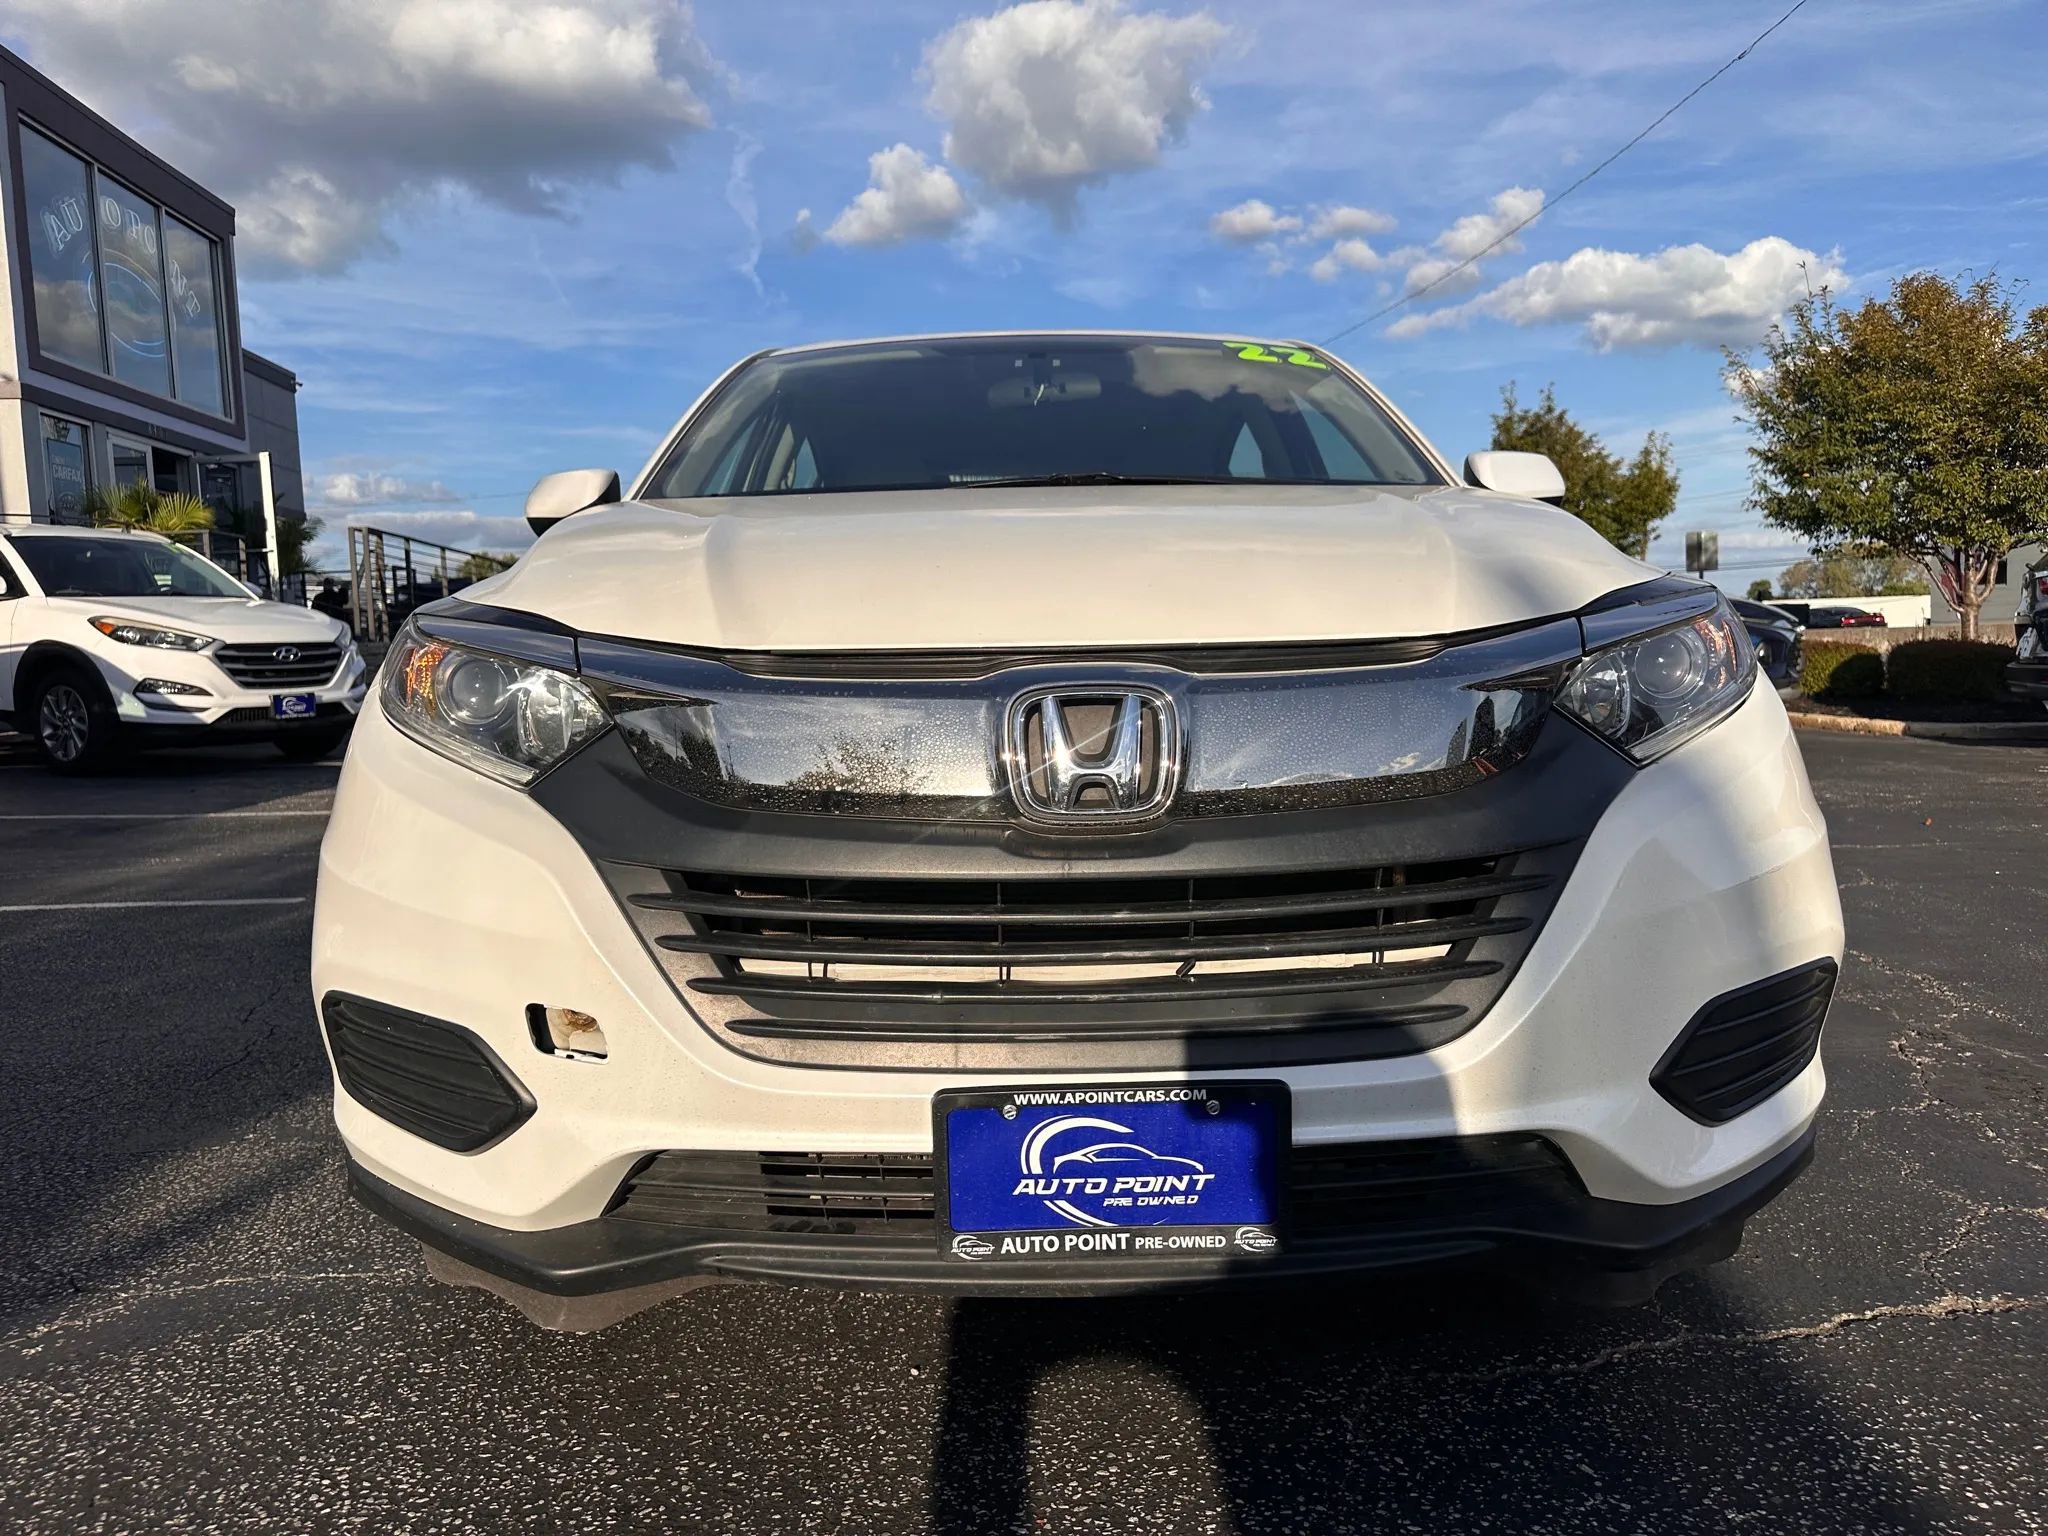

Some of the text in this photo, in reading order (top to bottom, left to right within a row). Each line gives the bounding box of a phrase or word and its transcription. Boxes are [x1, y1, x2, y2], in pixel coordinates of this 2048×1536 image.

[1222, 342, 1326, 369] 22
[52, 464, 82, 483] CARFAX
[1014, 1089, 1206, 1105] WWW.APOINTCARS.COM
[1012, 1174, 1215, 1195] AUTO POINT
[1103, 1195, 1198, 1206] PRE OWNED
[1001, 1233, 1226, 1254] AUTO POINT PRE-OWNED
